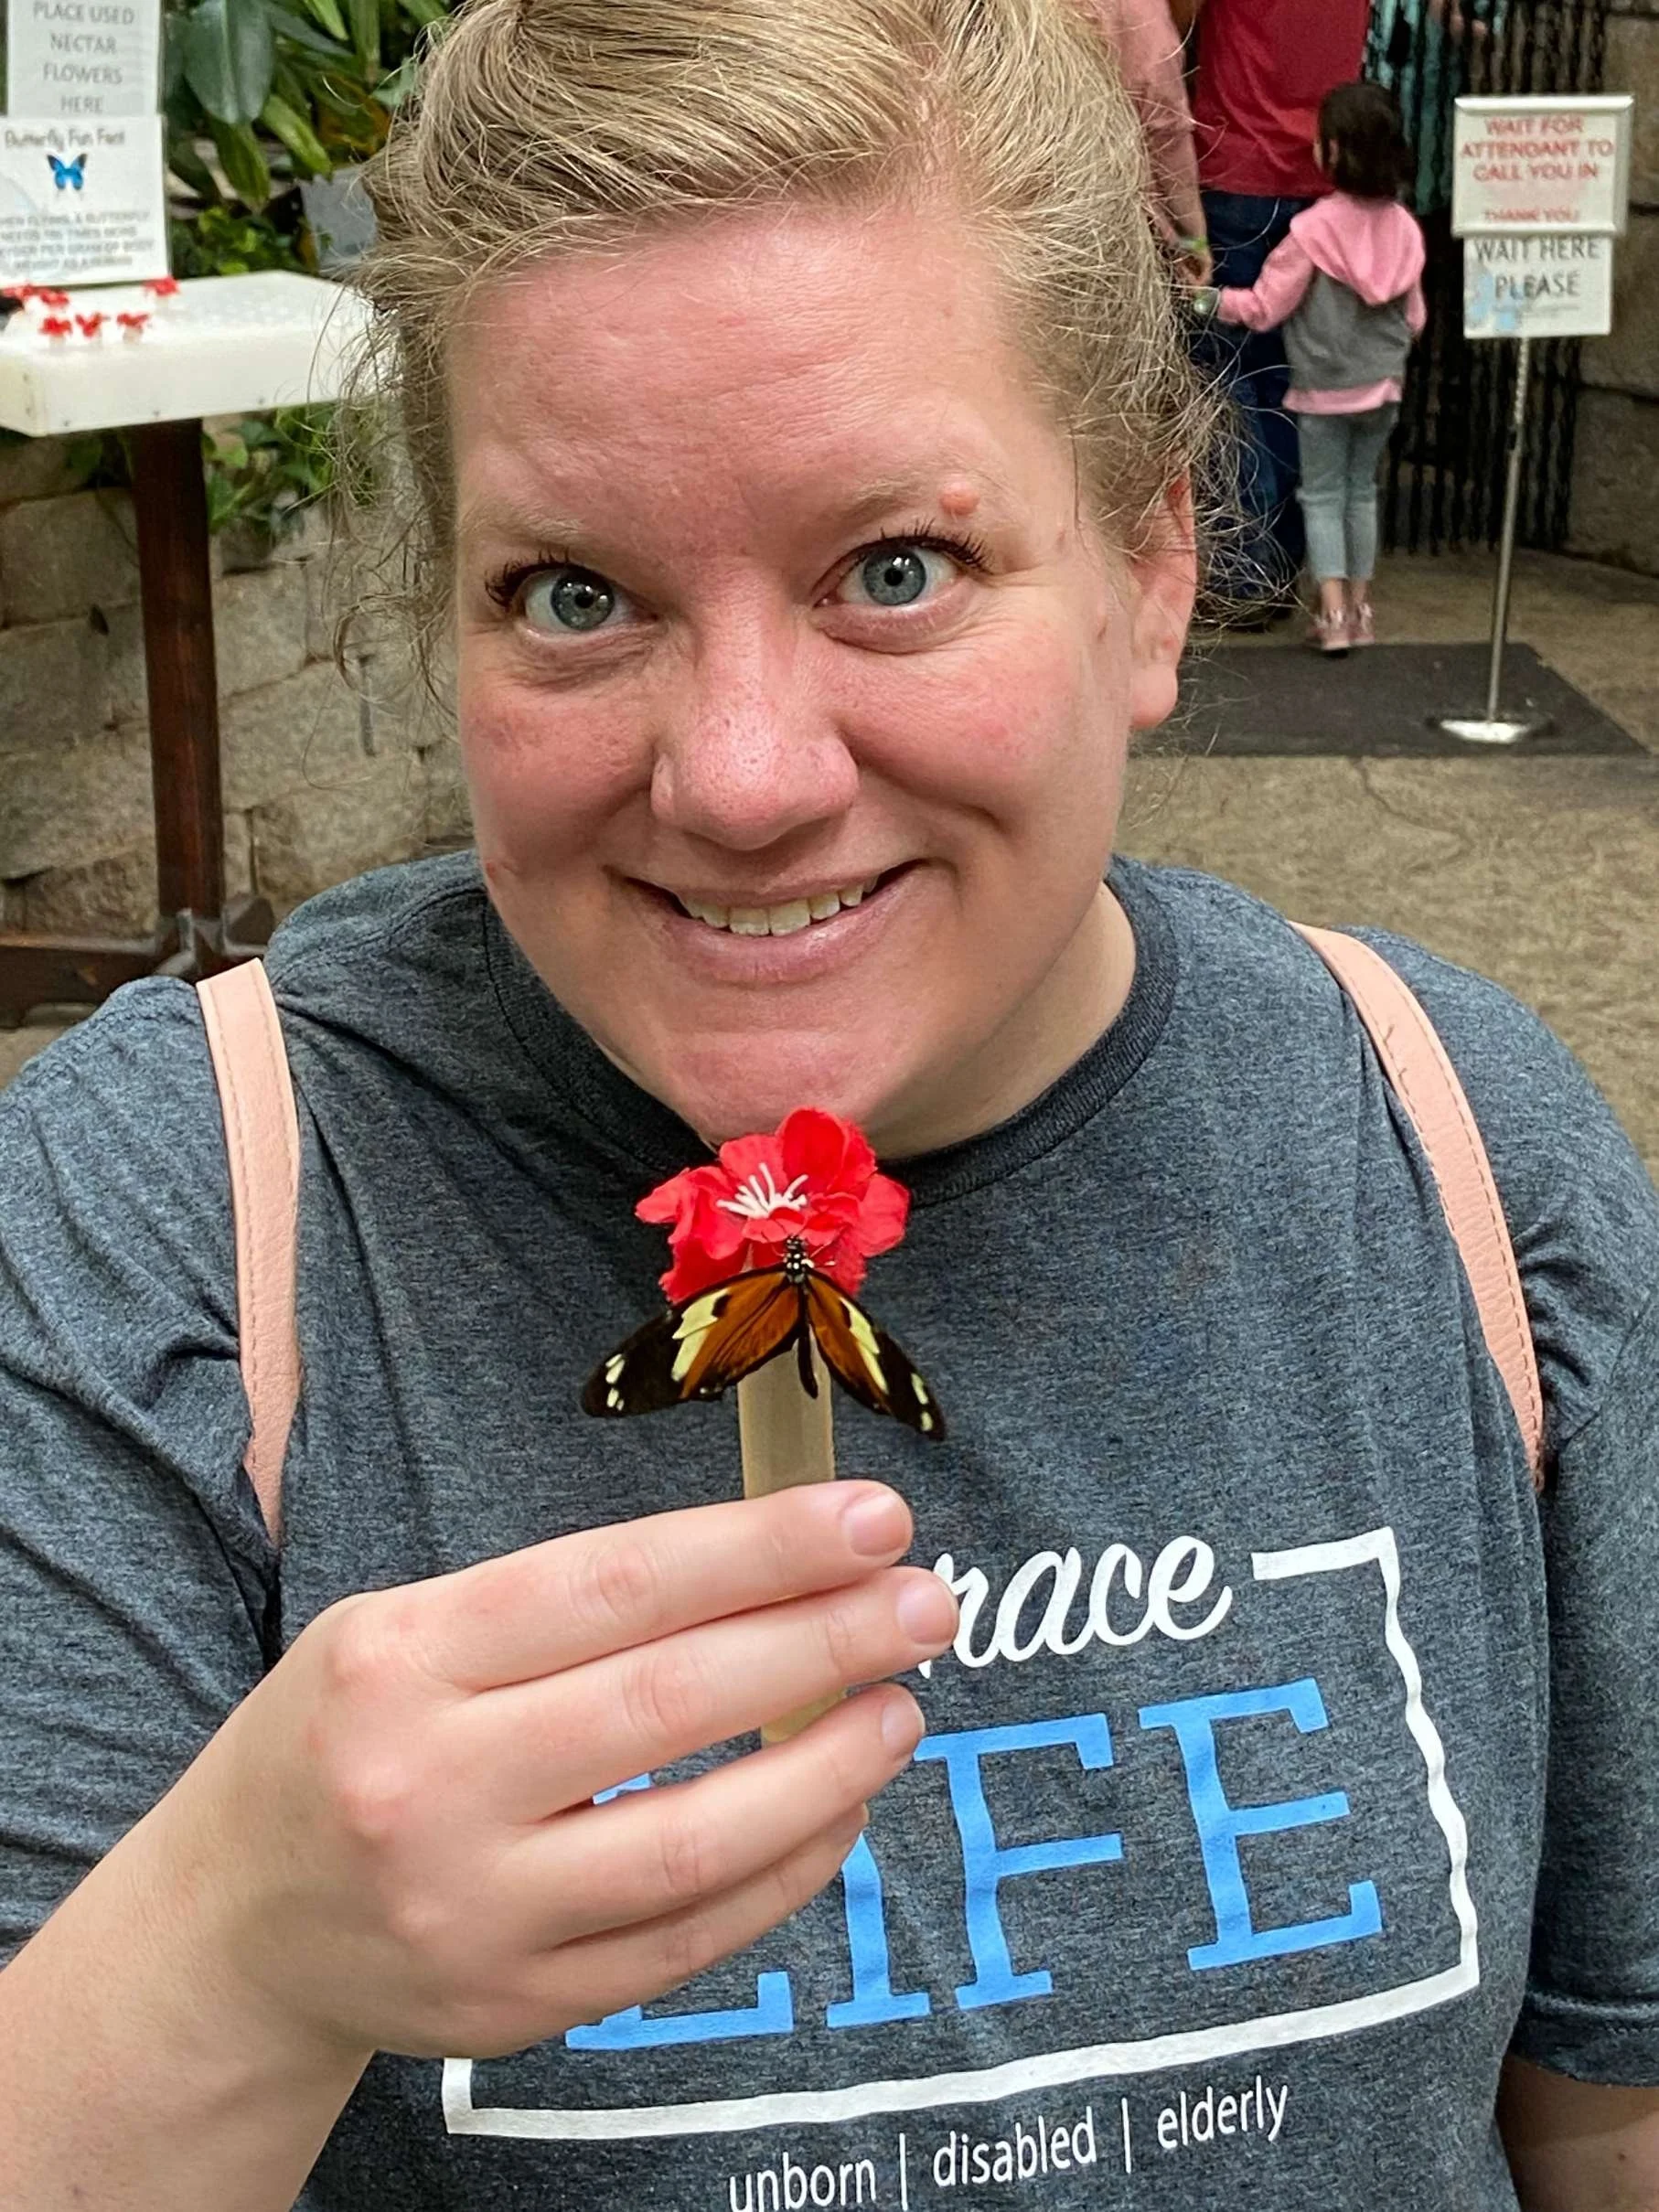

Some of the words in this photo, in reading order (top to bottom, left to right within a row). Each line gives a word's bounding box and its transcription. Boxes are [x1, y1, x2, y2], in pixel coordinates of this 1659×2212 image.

[33, 2, 84, 22] PLACE
[89, 5, 135, 25] USED
[49, 34, 118, 54] NECTAR
[43, 63, 123, 85] FLOWERS
[60, 96, 103, 113] HERE
[1485, 117, 1534, 135] WAIT
[1540, 114, 1584, 134] FOR
[1462, 140, 1580, 158] ATTENDANT
[1587, 138, 1615, 156] TO
[1472, 163, 1522, 181] CALL
[1528, 163, 1573, 179] YOU
[1578, 162, 1599, 178] IN
[1484, 208, 1540, 222] THANK
[1543, 207, 1581, 222] YOU
[1474, 236, 1529, 263] WAIT
[1540, 235, 1600, 260] HERE
[1494, 271, 1580, 300] PLEASE
[917, 1535, 1234, 1680] race
[729, 2152, 877, 2212] unborn
[932, 2105, 1097, 2188] disabled
[1156, 2075, 1289, 2151] elderly
